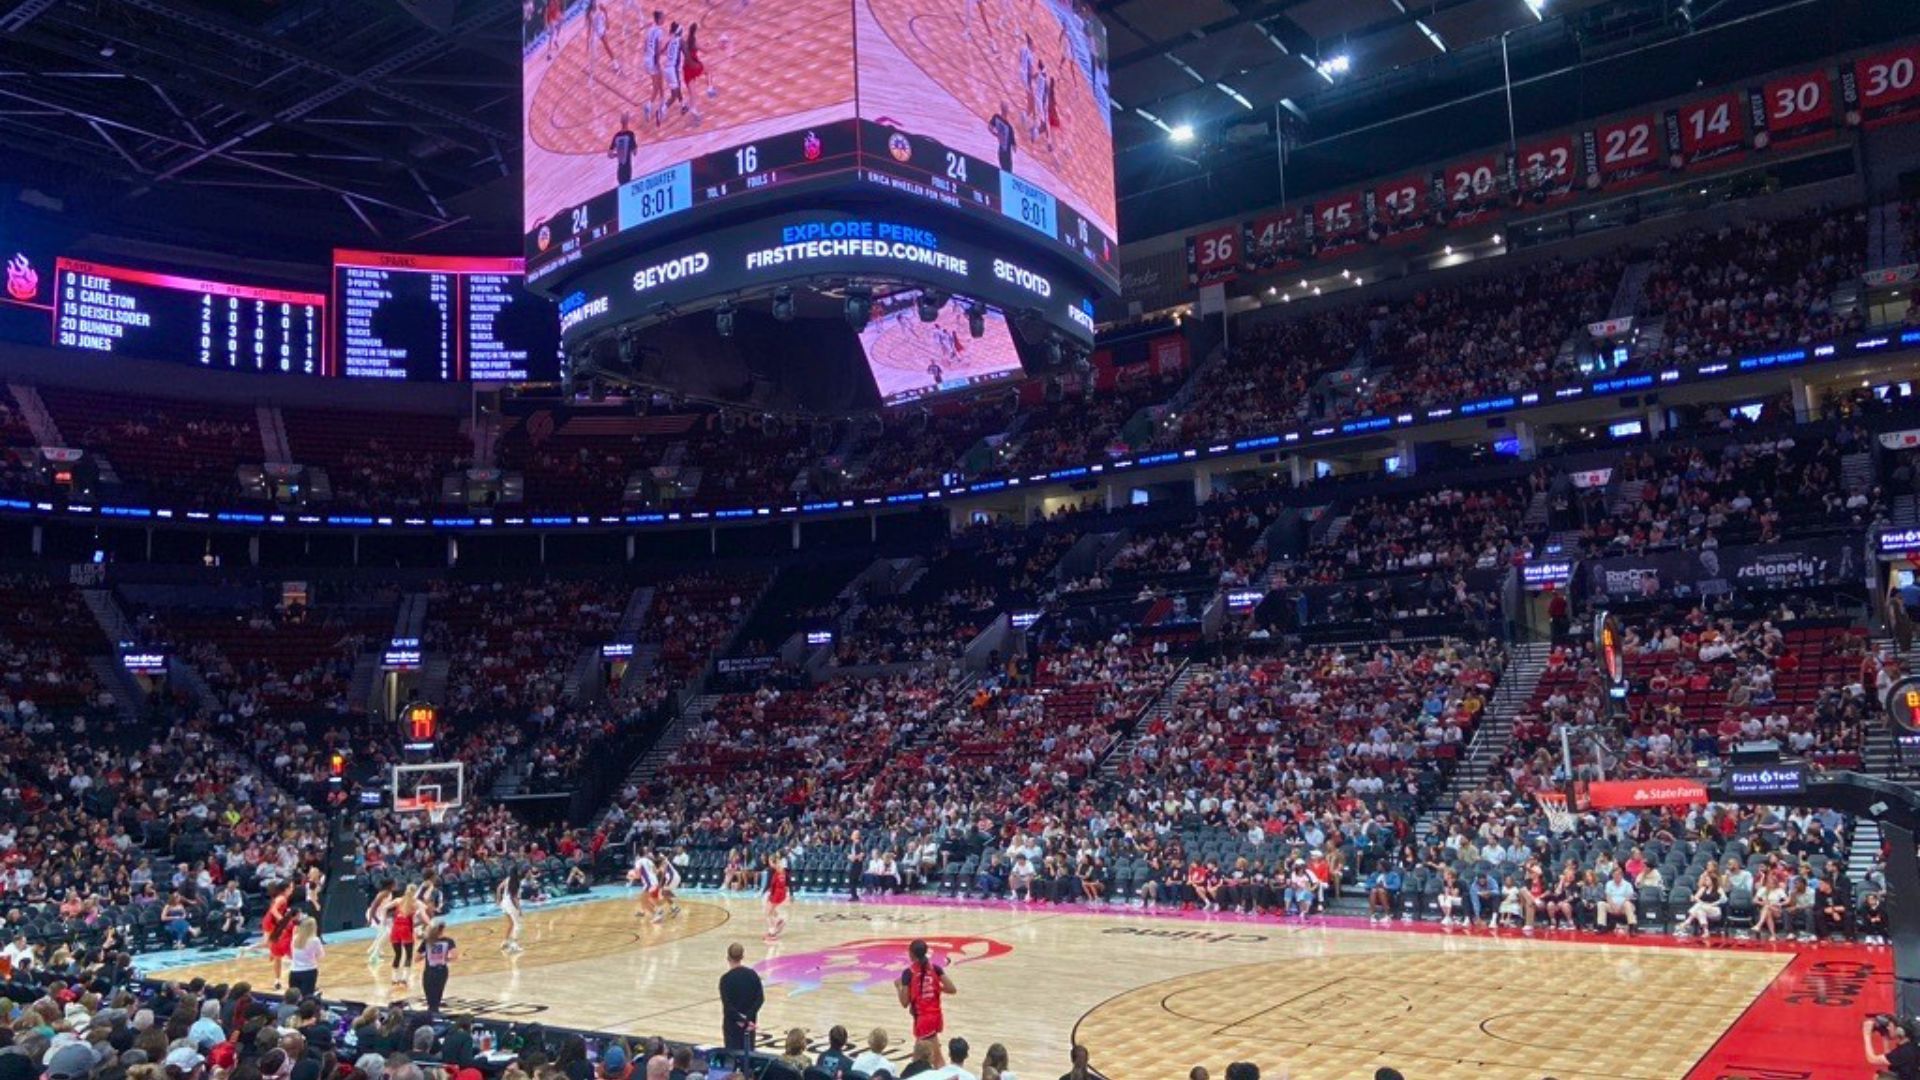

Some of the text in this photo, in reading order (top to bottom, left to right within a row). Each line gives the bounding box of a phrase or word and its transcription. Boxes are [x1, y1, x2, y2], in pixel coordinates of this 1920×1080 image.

[1865, 58, 1913, 96] 30
[1774, 82, 1820, 118] 30
[1689, 103, 1731, 139] 14
[736, 145, 757, 175] 16
[1605, 124, 1648, 163] 22
[946, 152, 967, 182] 24
[1453, 167, 1491, 200] 20
[572, 205, 588, 234] 24
[642, 186, 674, 217] 8:01
[1021, 197, 1047, 229] 8:01
[1322, 202, 1352, 232] 15
[783, 222, 937, 248] EXPLORE PERKS:
[1202, 234, 1232, 264] 36
[633, 252, 709, 291] BEYOND
[746, 239, 968, 276] FIRSTTECHFED.COM/FIRE
[67, 272, 313, 317] 0 LEITE 4 0 2 0 3
[993, 258, 1050, 297] BEYOND
[64, 302, 77, 315] 15
[228, 325, 237, 337] 3
[255, 327, 263, 340] 0
[283, 331, 289, 343] 1
[307, 333, 312, 345] 1
[80, 290, 135, 310] CARLETON
[203, 308, 210, 320] 2
[230, 311, 237, 323] 0
[258, 314, 263, 326] 1
[282, 317, 289, 329] 0
[307, 320, 312, 331] 1
[61, 332, 76, 345] 30
[78, 335, 111, 351] JONES
[201, 350, 210, 363] 2
[230, 353, 235, 366] 1
[257, 356, 262, 368] 1
[305, 360, 313, 373] 2
[62, 316, 312, 358] 20 BUHNER 0 0 0 0 1
[1732, 771, 1799, 783] First Tech
